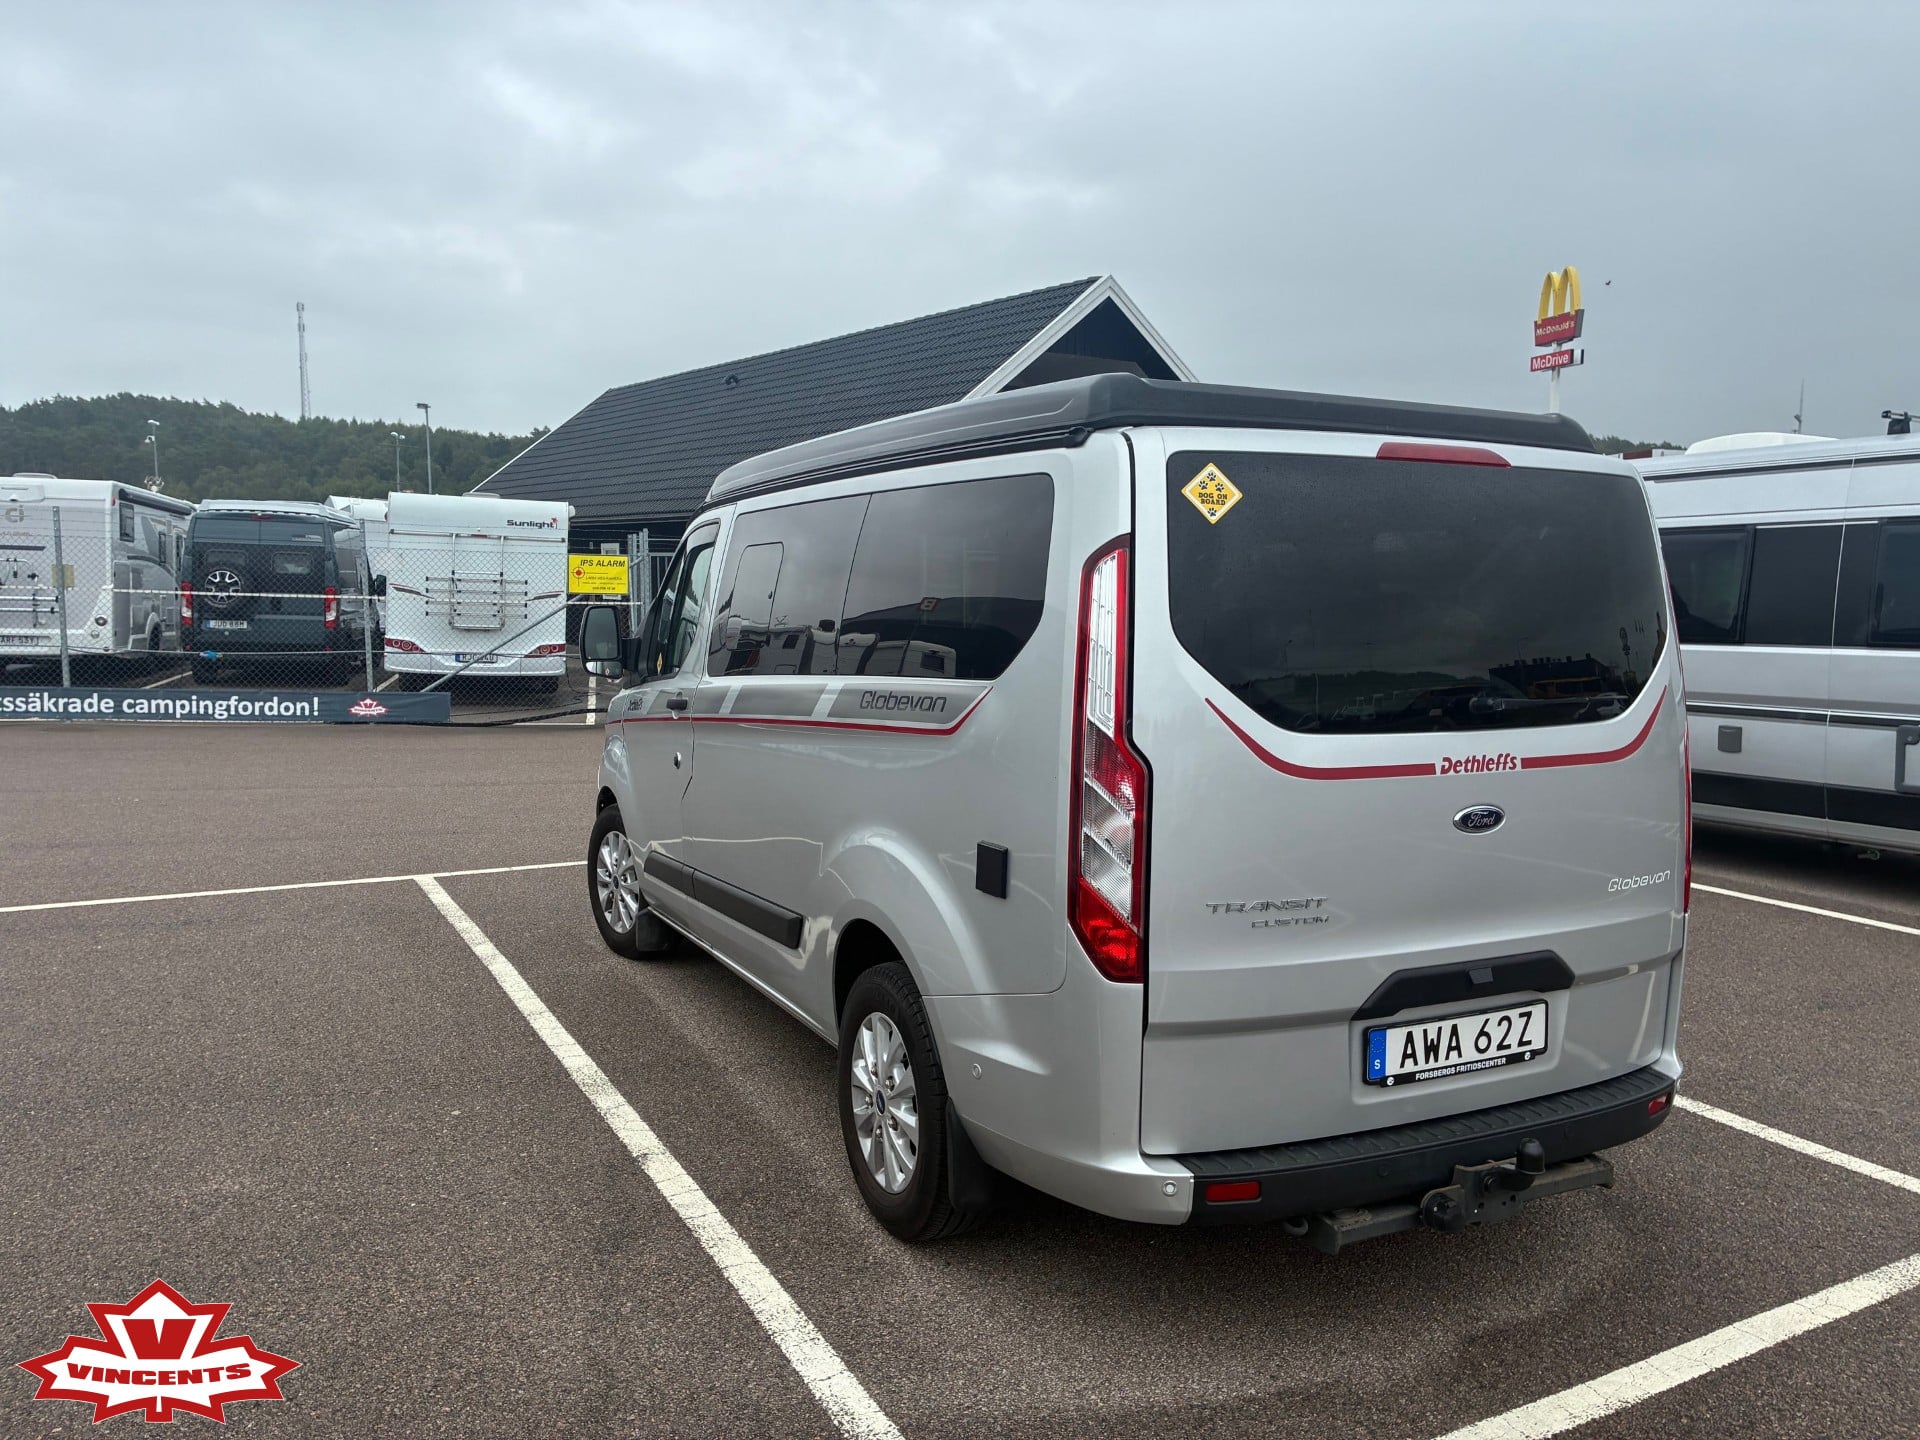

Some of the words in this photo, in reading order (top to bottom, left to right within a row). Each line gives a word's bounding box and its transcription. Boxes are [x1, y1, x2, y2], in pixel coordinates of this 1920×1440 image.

[1536, 320, 1575, 337] McDonald's
[1532, 353, 1569, 370] McDrive
[506, 519, 555, 529] Sunlight
[580, 559, 594, 567] IPS
[595, 559, 626, 567] ALARM
[122, 695, 319, 719] campingfordon!
[859, 690, 947, 713] Globevan
[1440, 753, 1518, 775] Dethleffs
[1468, 811, 1496, 828] Ford
[1607, 869, 1671, 892] Globevan
[1205, 897, 1328, 914] TRANSIT
[1251, 916, 1330, 928] CUSTOM
[1400, 1023, 1463, 1069] AWA
[1474, 1010, 1533, 1054] 62Z
[1373, 1059, 1381, 1070] S
[1415, 1066, 1456, 1081] FORSBERGS
[1456, 1057, 1506, 1074] FRITIDSCENTER
